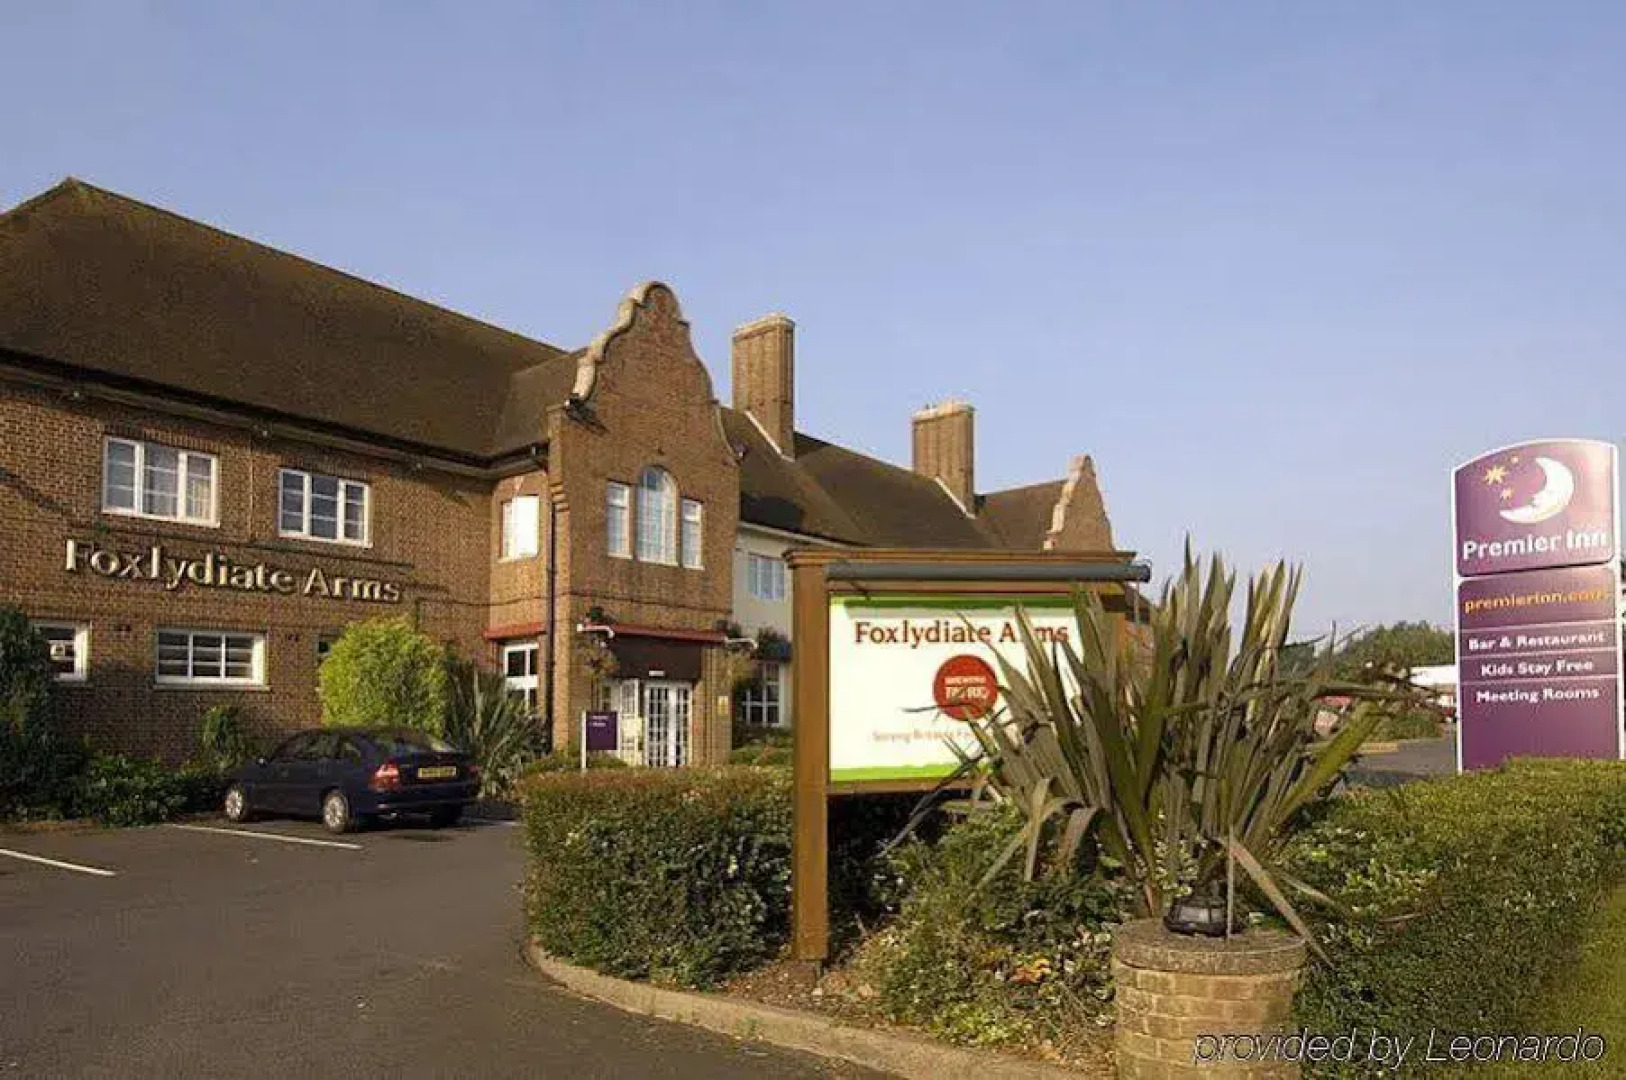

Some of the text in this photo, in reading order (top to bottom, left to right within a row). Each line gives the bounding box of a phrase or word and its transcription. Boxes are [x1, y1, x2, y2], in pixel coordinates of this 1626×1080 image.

[1462, 527, 1608, 561] Premier Inn
[65, 538, 401, 602] Foxlydiate Arms
[855, 619, 1068, 649] Foxlydiate Ams
[1468, 631, 1605, 650] Bar & Restaurant
[1481, 659, 1594, 677] Kids Stay Free
[1475, 687, 1600, 704] Meeting Rooms
